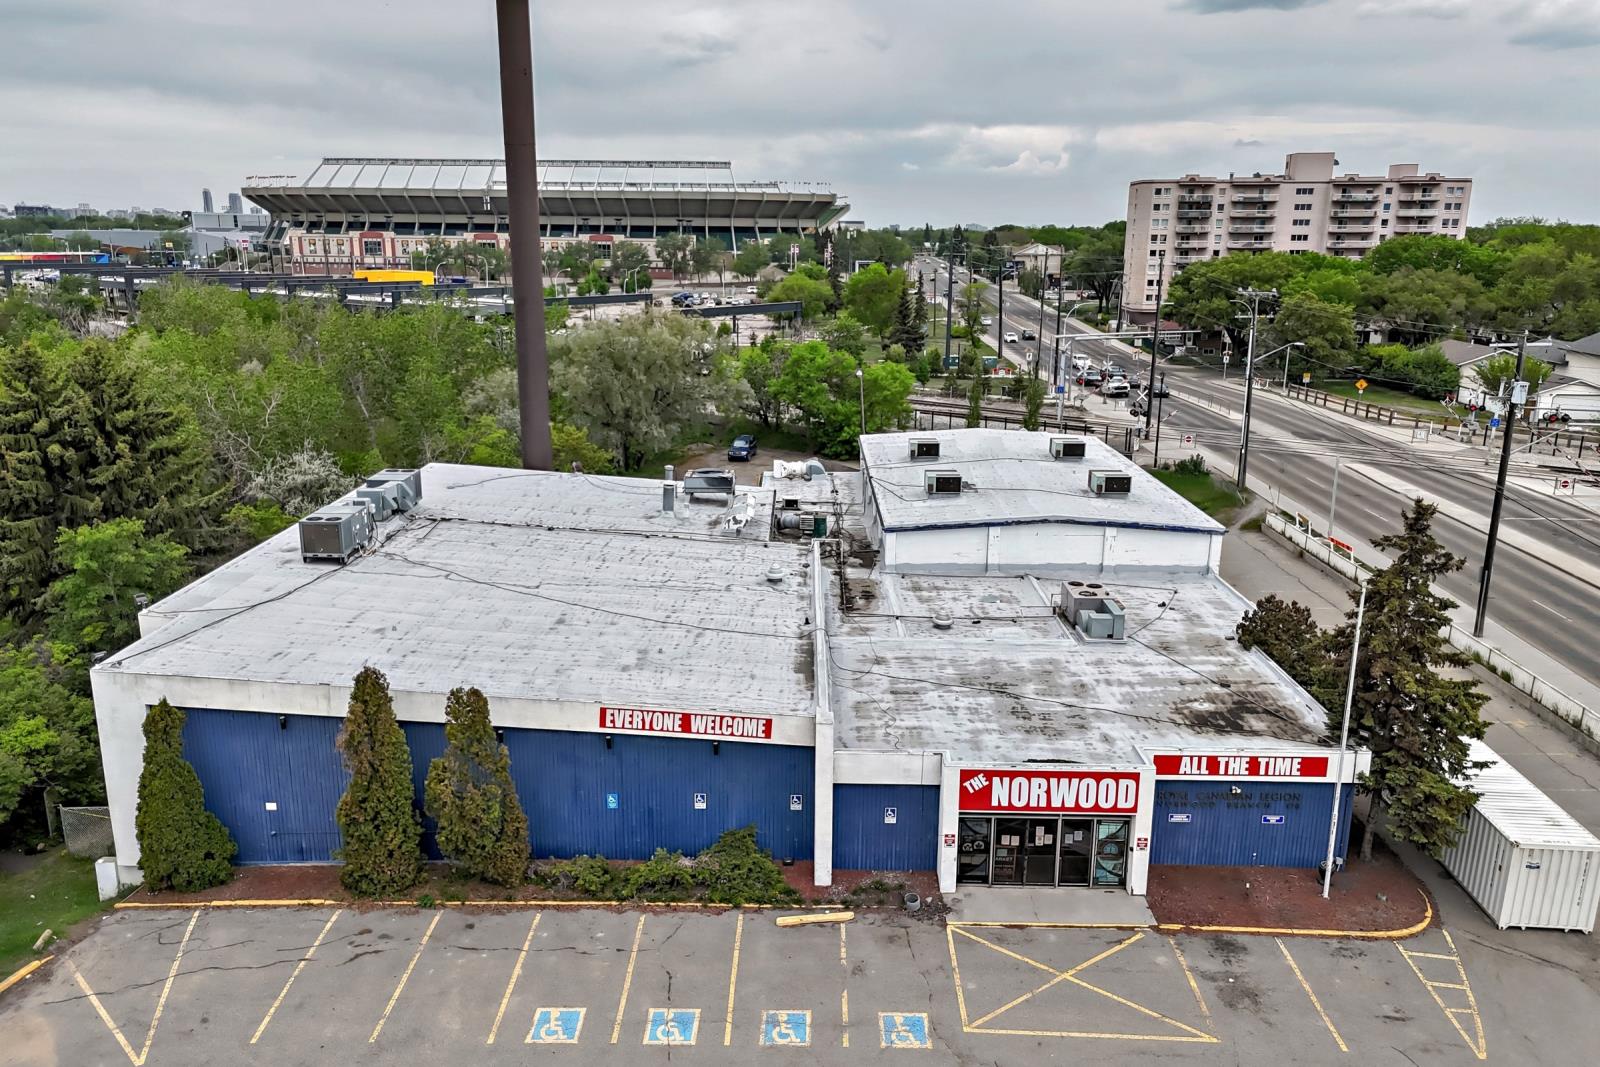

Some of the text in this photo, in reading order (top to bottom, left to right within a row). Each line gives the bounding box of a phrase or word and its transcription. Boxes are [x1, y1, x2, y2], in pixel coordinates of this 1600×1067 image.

[605, 708, 767, 738] EVERYONE WELCOME
[1178, 756, 1302, 777] ALL THE TIME
[962, 772, 1137, 809] THE NORWOOD
[1260, 791, 1301, 802] LEGION
